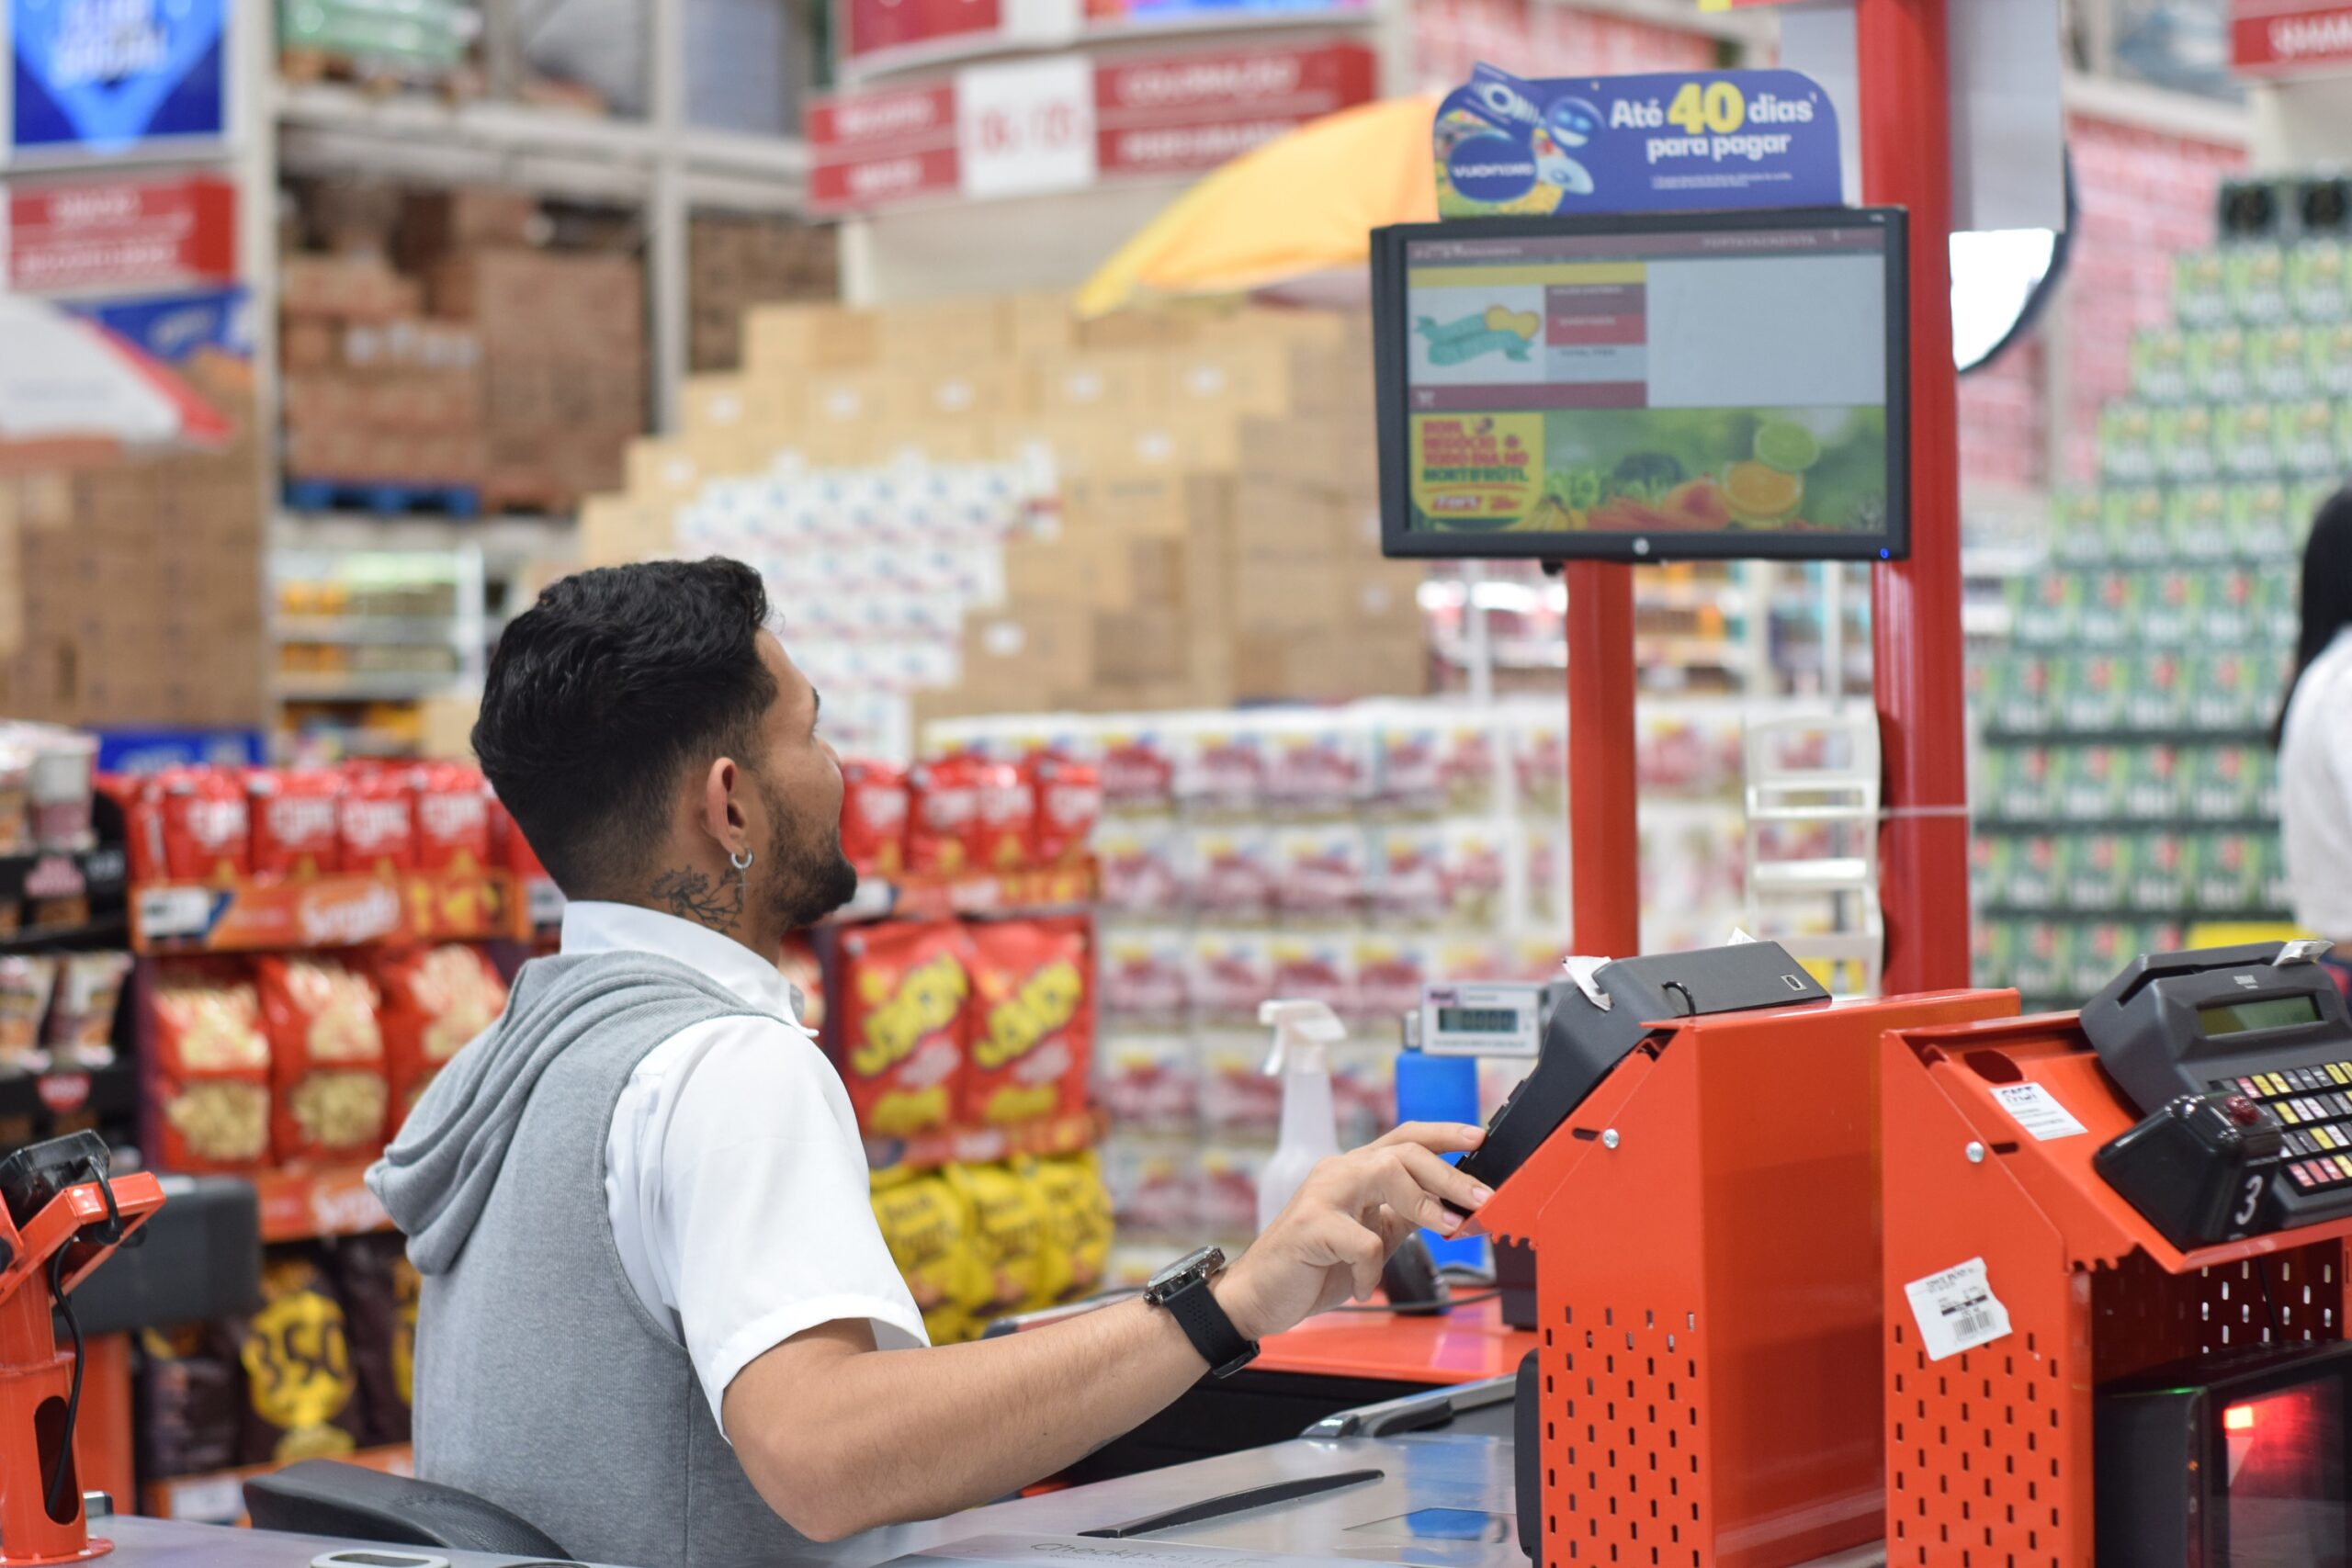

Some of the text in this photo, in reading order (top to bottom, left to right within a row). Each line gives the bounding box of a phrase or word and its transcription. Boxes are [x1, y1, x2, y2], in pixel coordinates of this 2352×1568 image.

[1611, 97, 1664, 129] Até
[1668, 81, 1745, 134] 40
[1646, 133, 1792, 164] para pagar
[2234, 1175, 2264, 1225] 3
